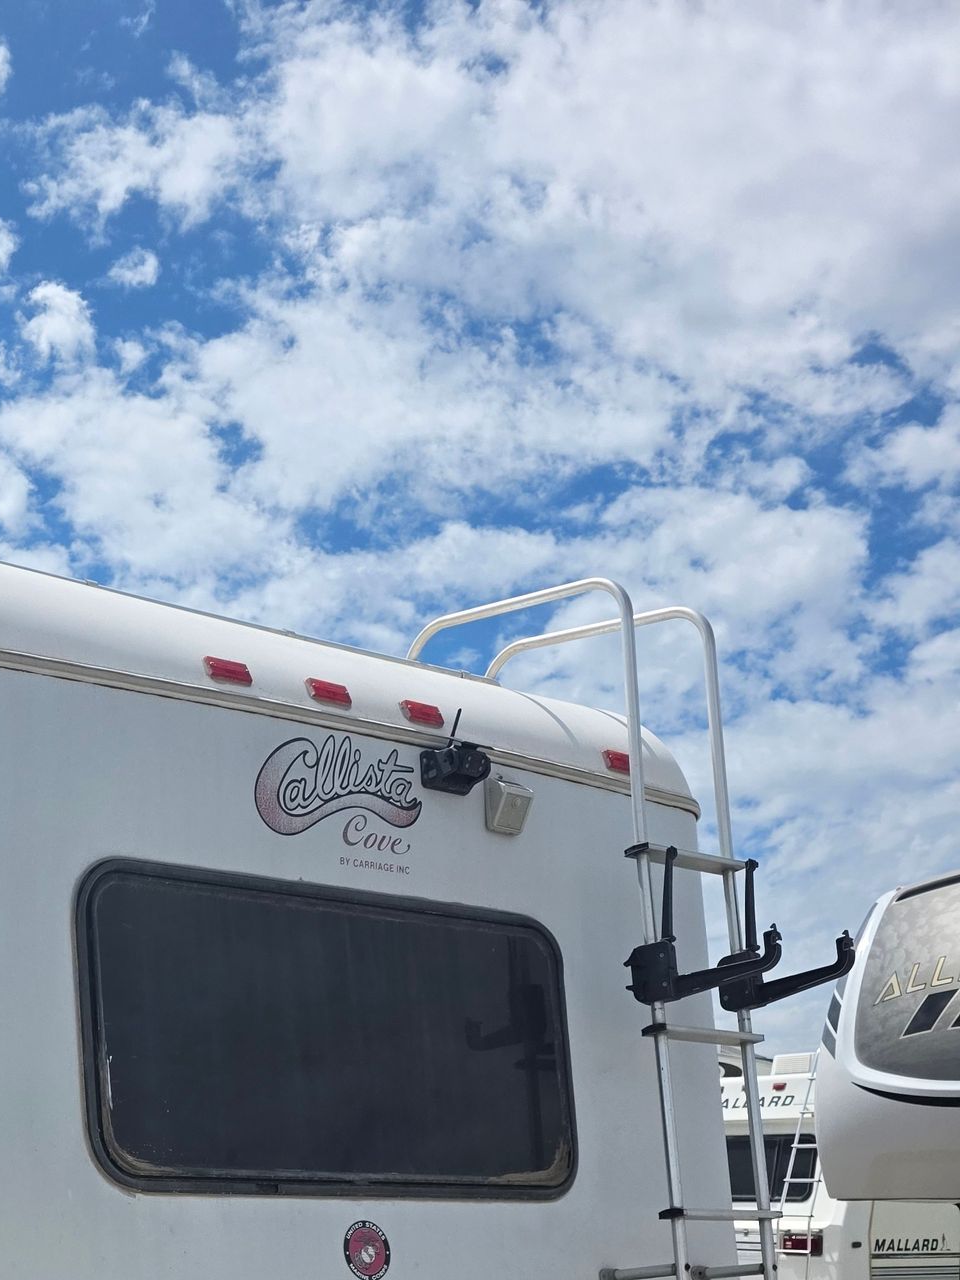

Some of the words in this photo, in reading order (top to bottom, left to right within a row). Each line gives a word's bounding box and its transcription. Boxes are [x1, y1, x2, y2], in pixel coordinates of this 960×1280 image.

[255, 735, 422, 836] Callista
[342, 814, 411, 855] Cove
[339, 857, 351, 866] BY
[352, 858, 395, 873] CARRIAGE
[396, 865, 410, 875] INC
[873, 956, 960, 1007] ALL
[346, 1222, 363, 1240] UNITED
[365, 1221, 386, 1241] STATES
[873, 1238, 939, 1252] MALLARD
[371, 1264, 388, 1280] CORPS
